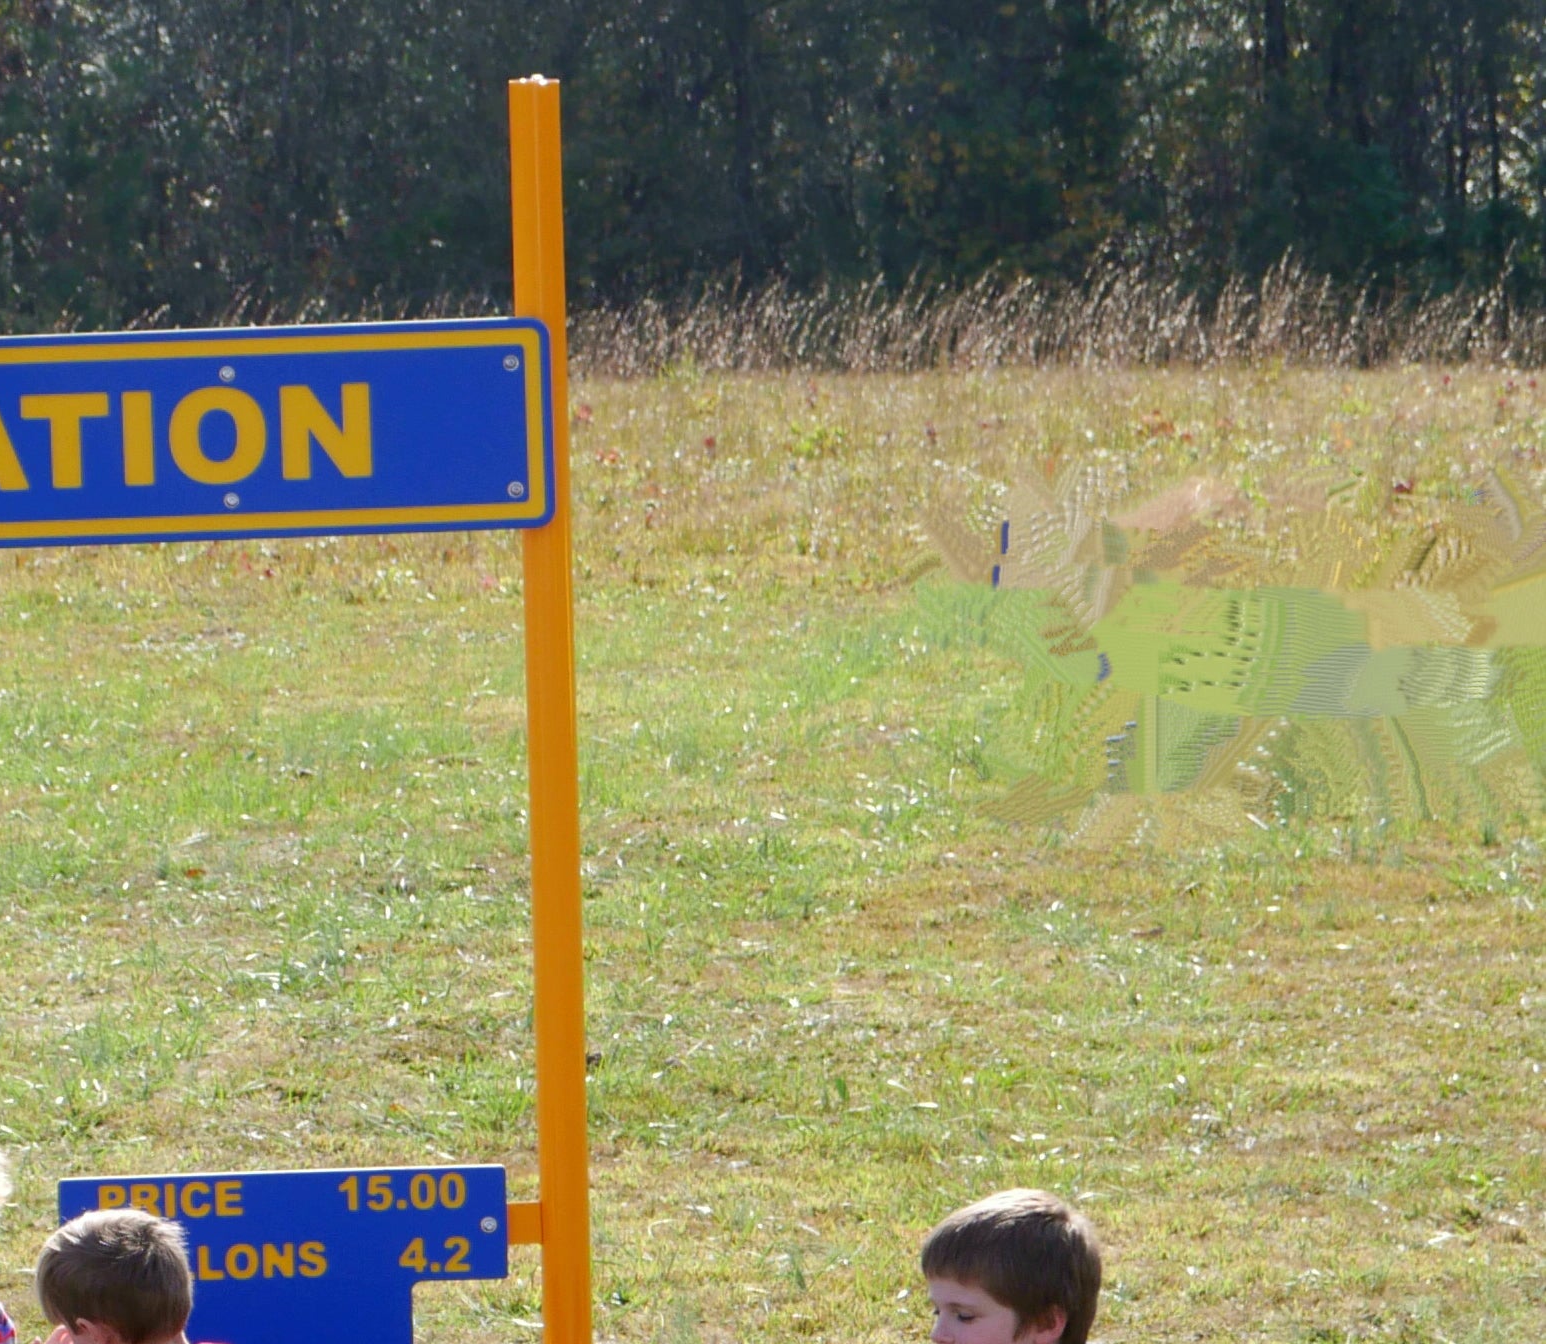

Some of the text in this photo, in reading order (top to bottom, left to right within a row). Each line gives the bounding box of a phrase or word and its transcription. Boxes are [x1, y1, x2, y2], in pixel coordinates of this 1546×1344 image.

[97, 1172, 467, 1220] PRICE 15.00
[192, 1236, 472, 1281] LONS 4.2
